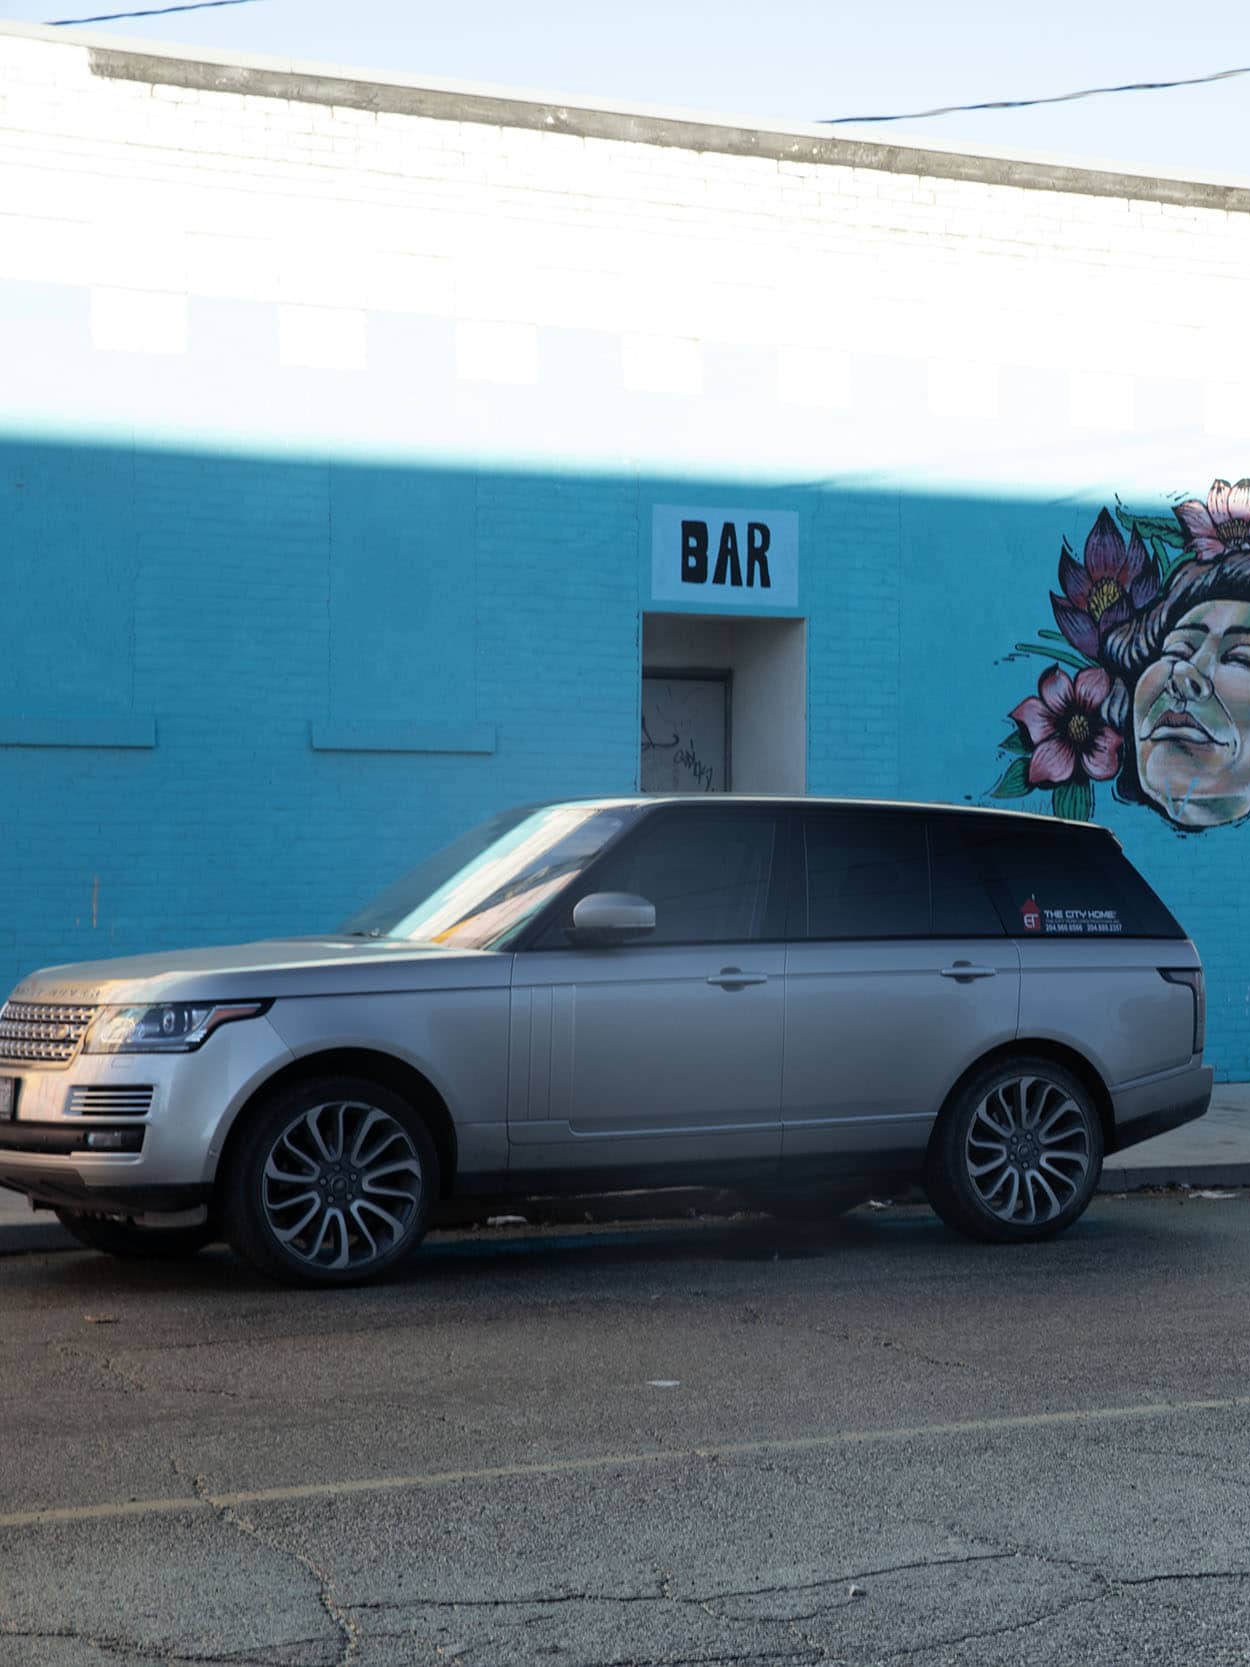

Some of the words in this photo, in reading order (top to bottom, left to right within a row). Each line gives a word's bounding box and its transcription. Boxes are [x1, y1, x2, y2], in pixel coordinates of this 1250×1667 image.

[681, 520, 771, 588] BAR
[1044, 910, 1063, 919] THE
[1065, 910, 1087, 919] CITY
